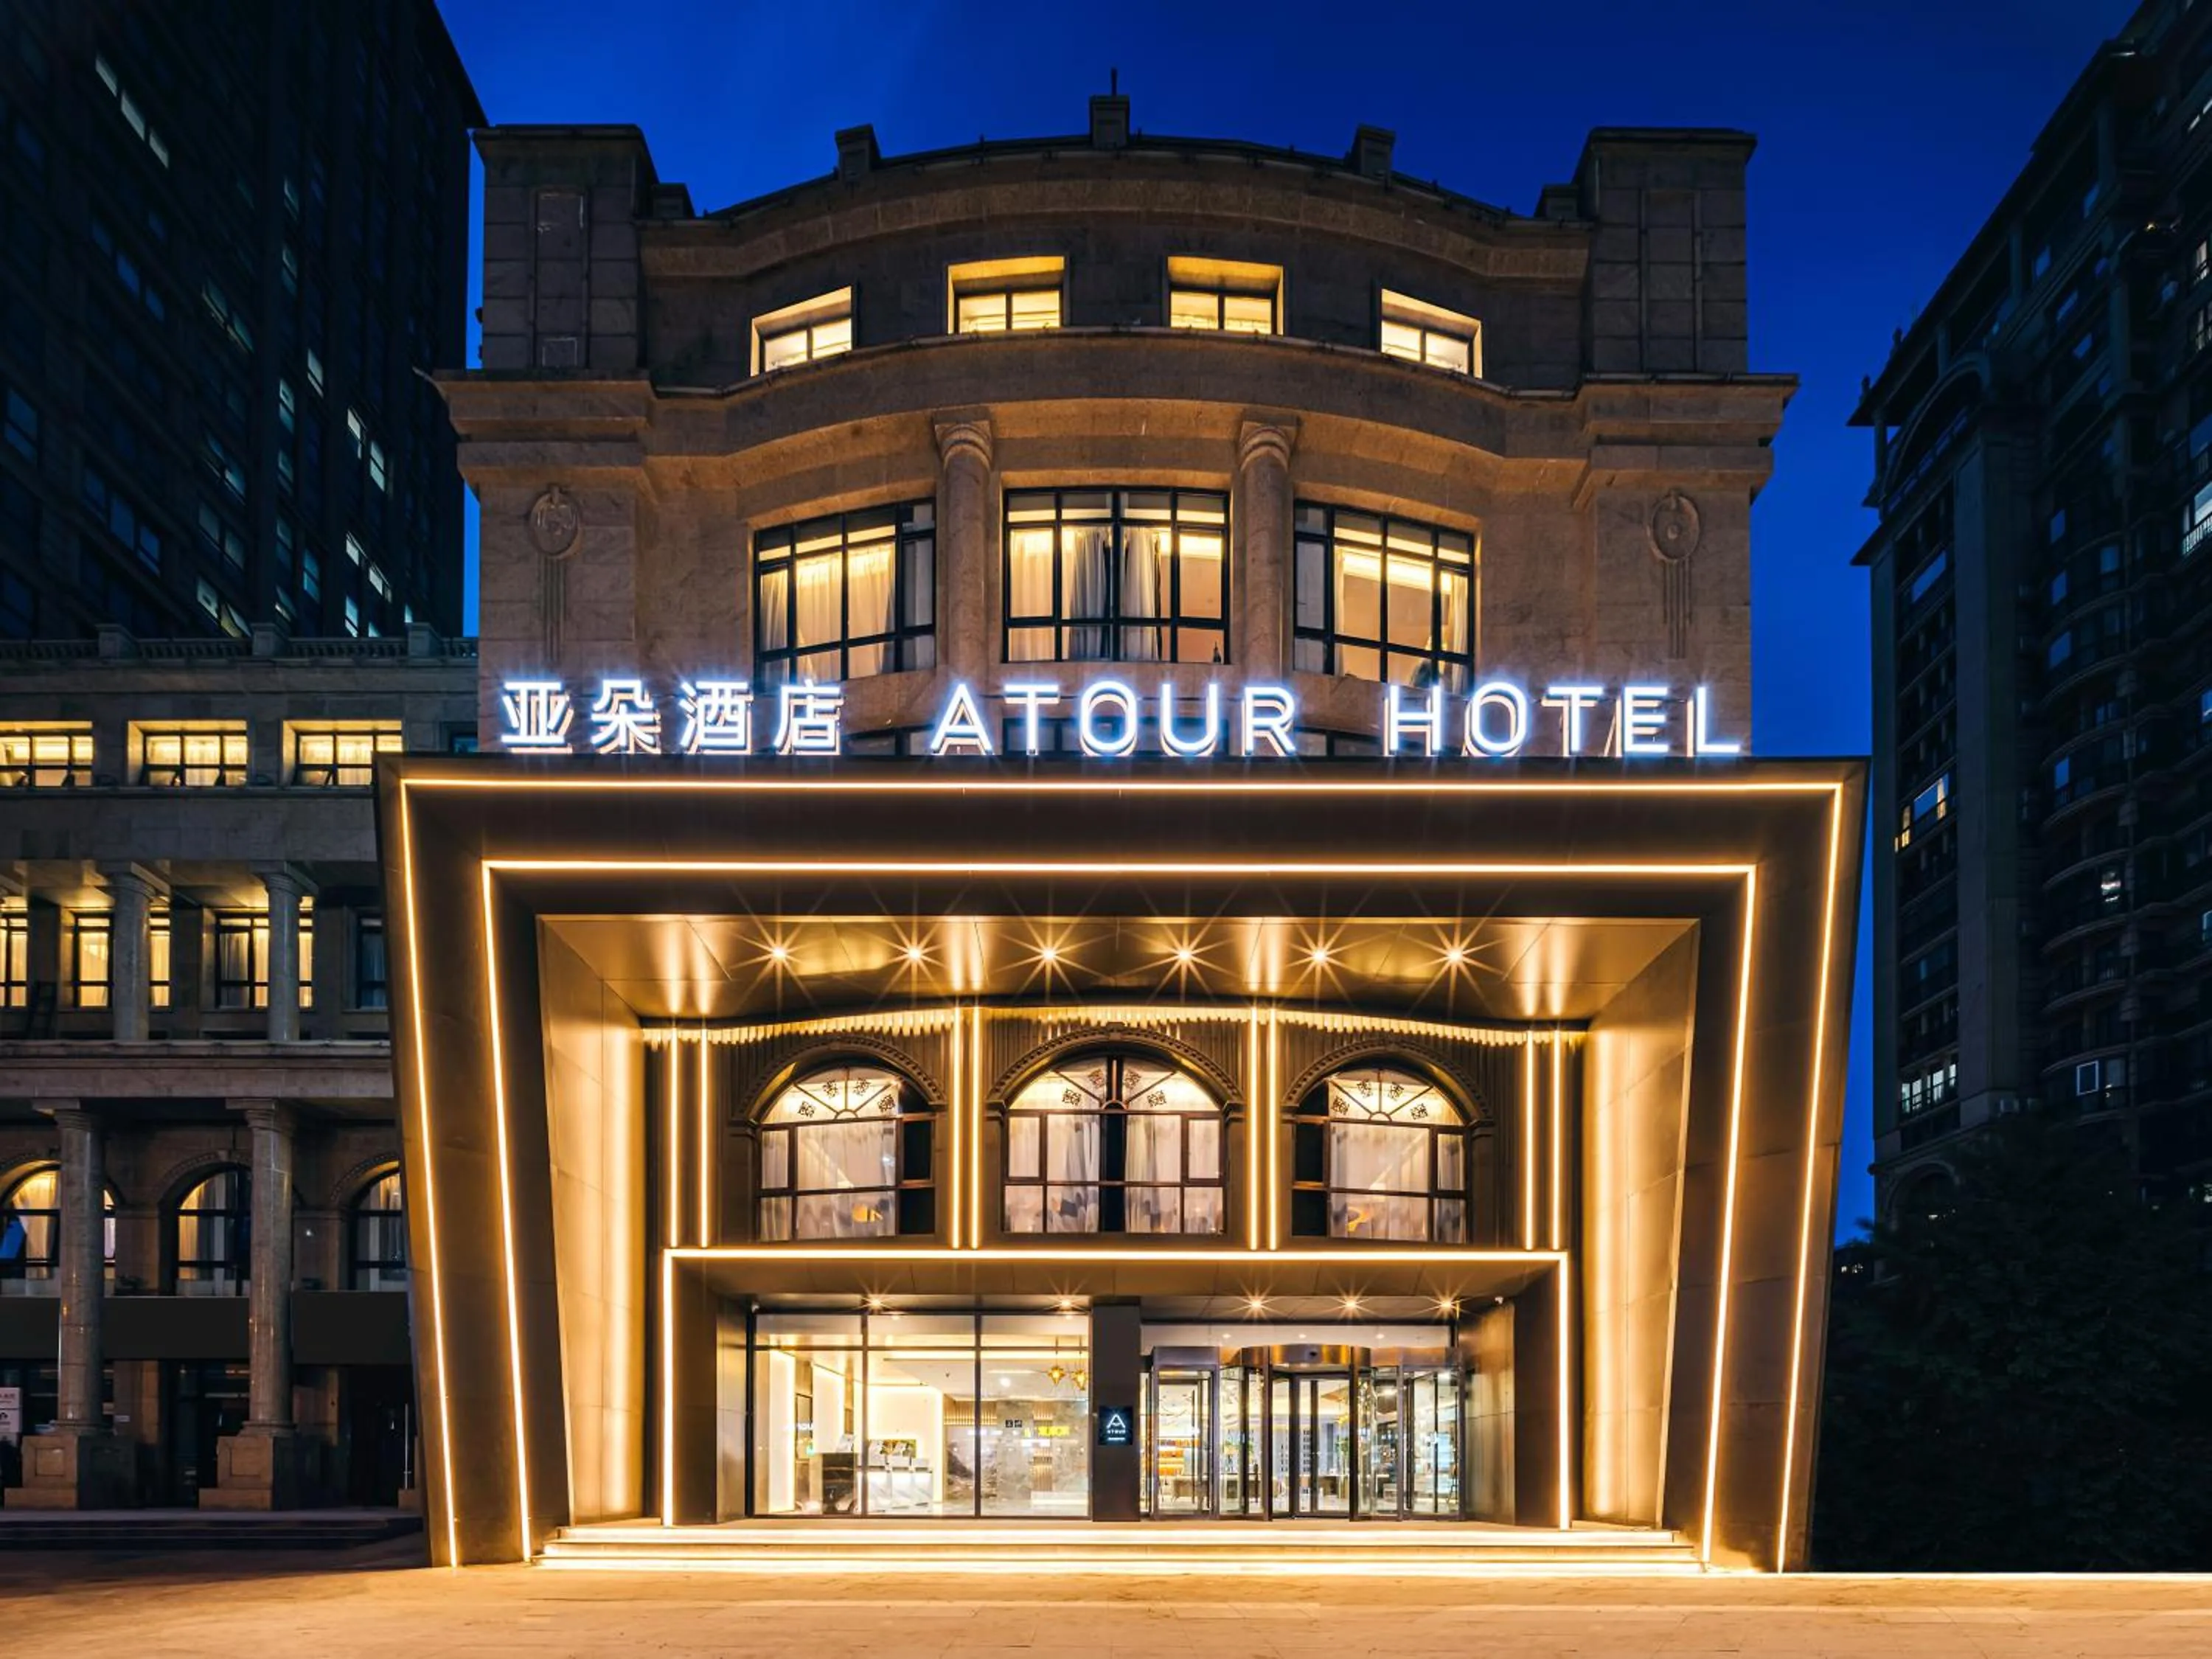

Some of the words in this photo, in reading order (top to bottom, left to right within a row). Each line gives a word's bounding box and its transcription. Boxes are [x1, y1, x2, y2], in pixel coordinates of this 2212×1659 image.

[501, 678, 841, 748] 亚朵酒店
[931, 681, 1296, 753] ATOUR
[1389, 682, 1741, 753] HOTEL
